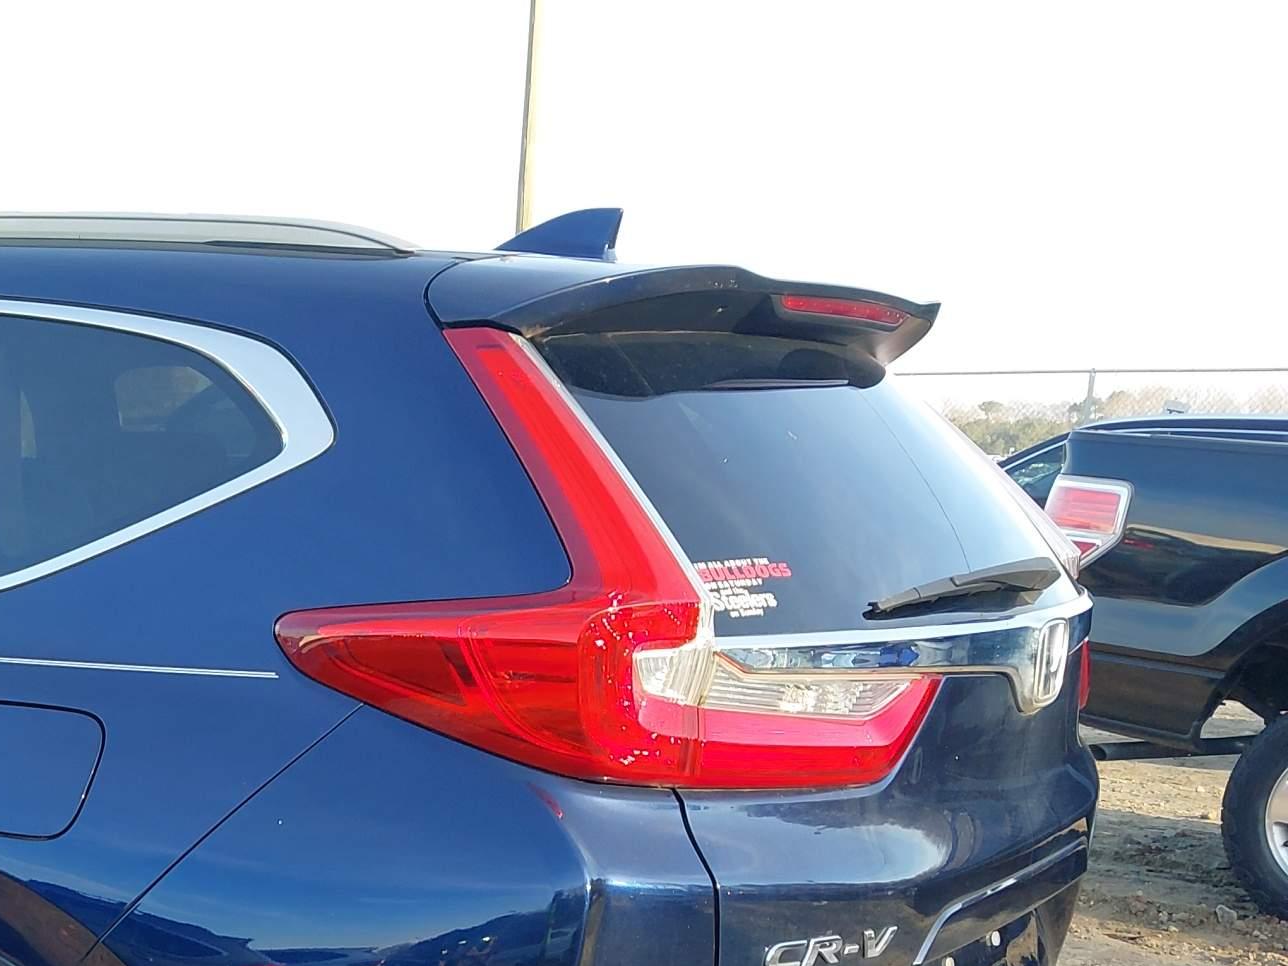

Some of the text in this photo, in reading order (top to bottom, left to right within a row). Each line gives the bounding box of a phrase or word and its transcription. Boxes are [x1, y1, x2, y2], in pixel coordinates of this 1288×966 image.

[724, 558, 751, 568] ABOUT
[752, 557, 770, 565] THE
[699, 563, 792, 581] BULLDOGS
[718, 578, 763, 588] SATURDAY
[710, 592, 777, 612] Steelers
